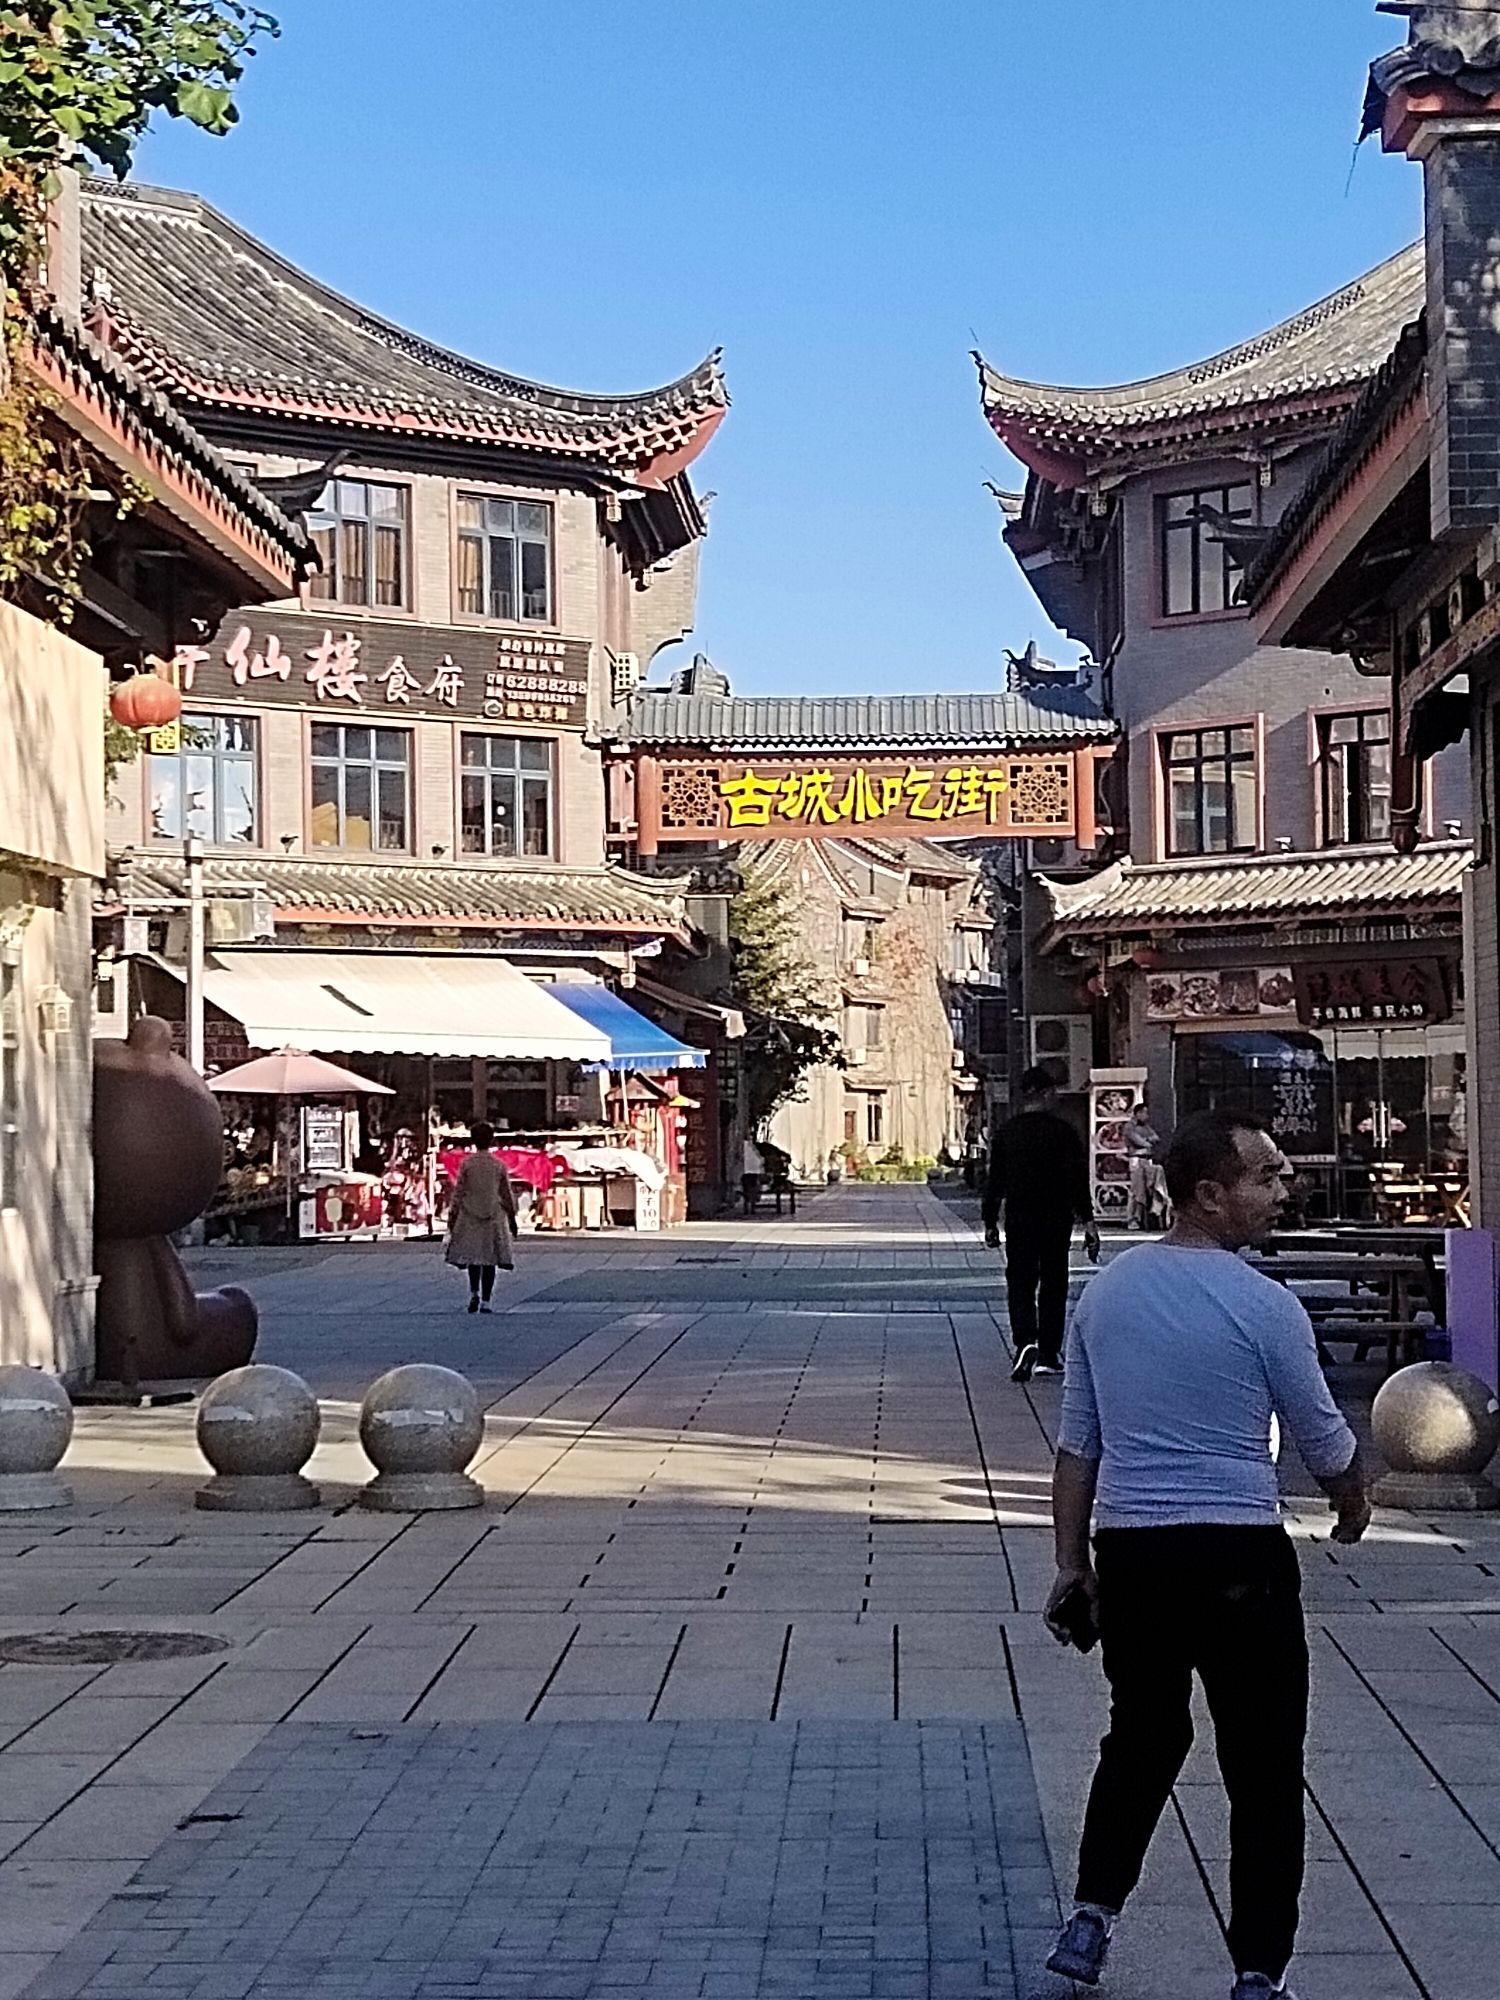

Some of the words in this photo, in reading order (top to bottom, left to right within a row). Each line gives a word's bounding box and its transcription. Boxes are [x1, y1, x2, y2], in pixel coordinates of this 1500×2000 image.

[720, 767, 1008, 827] 古城小吃街
